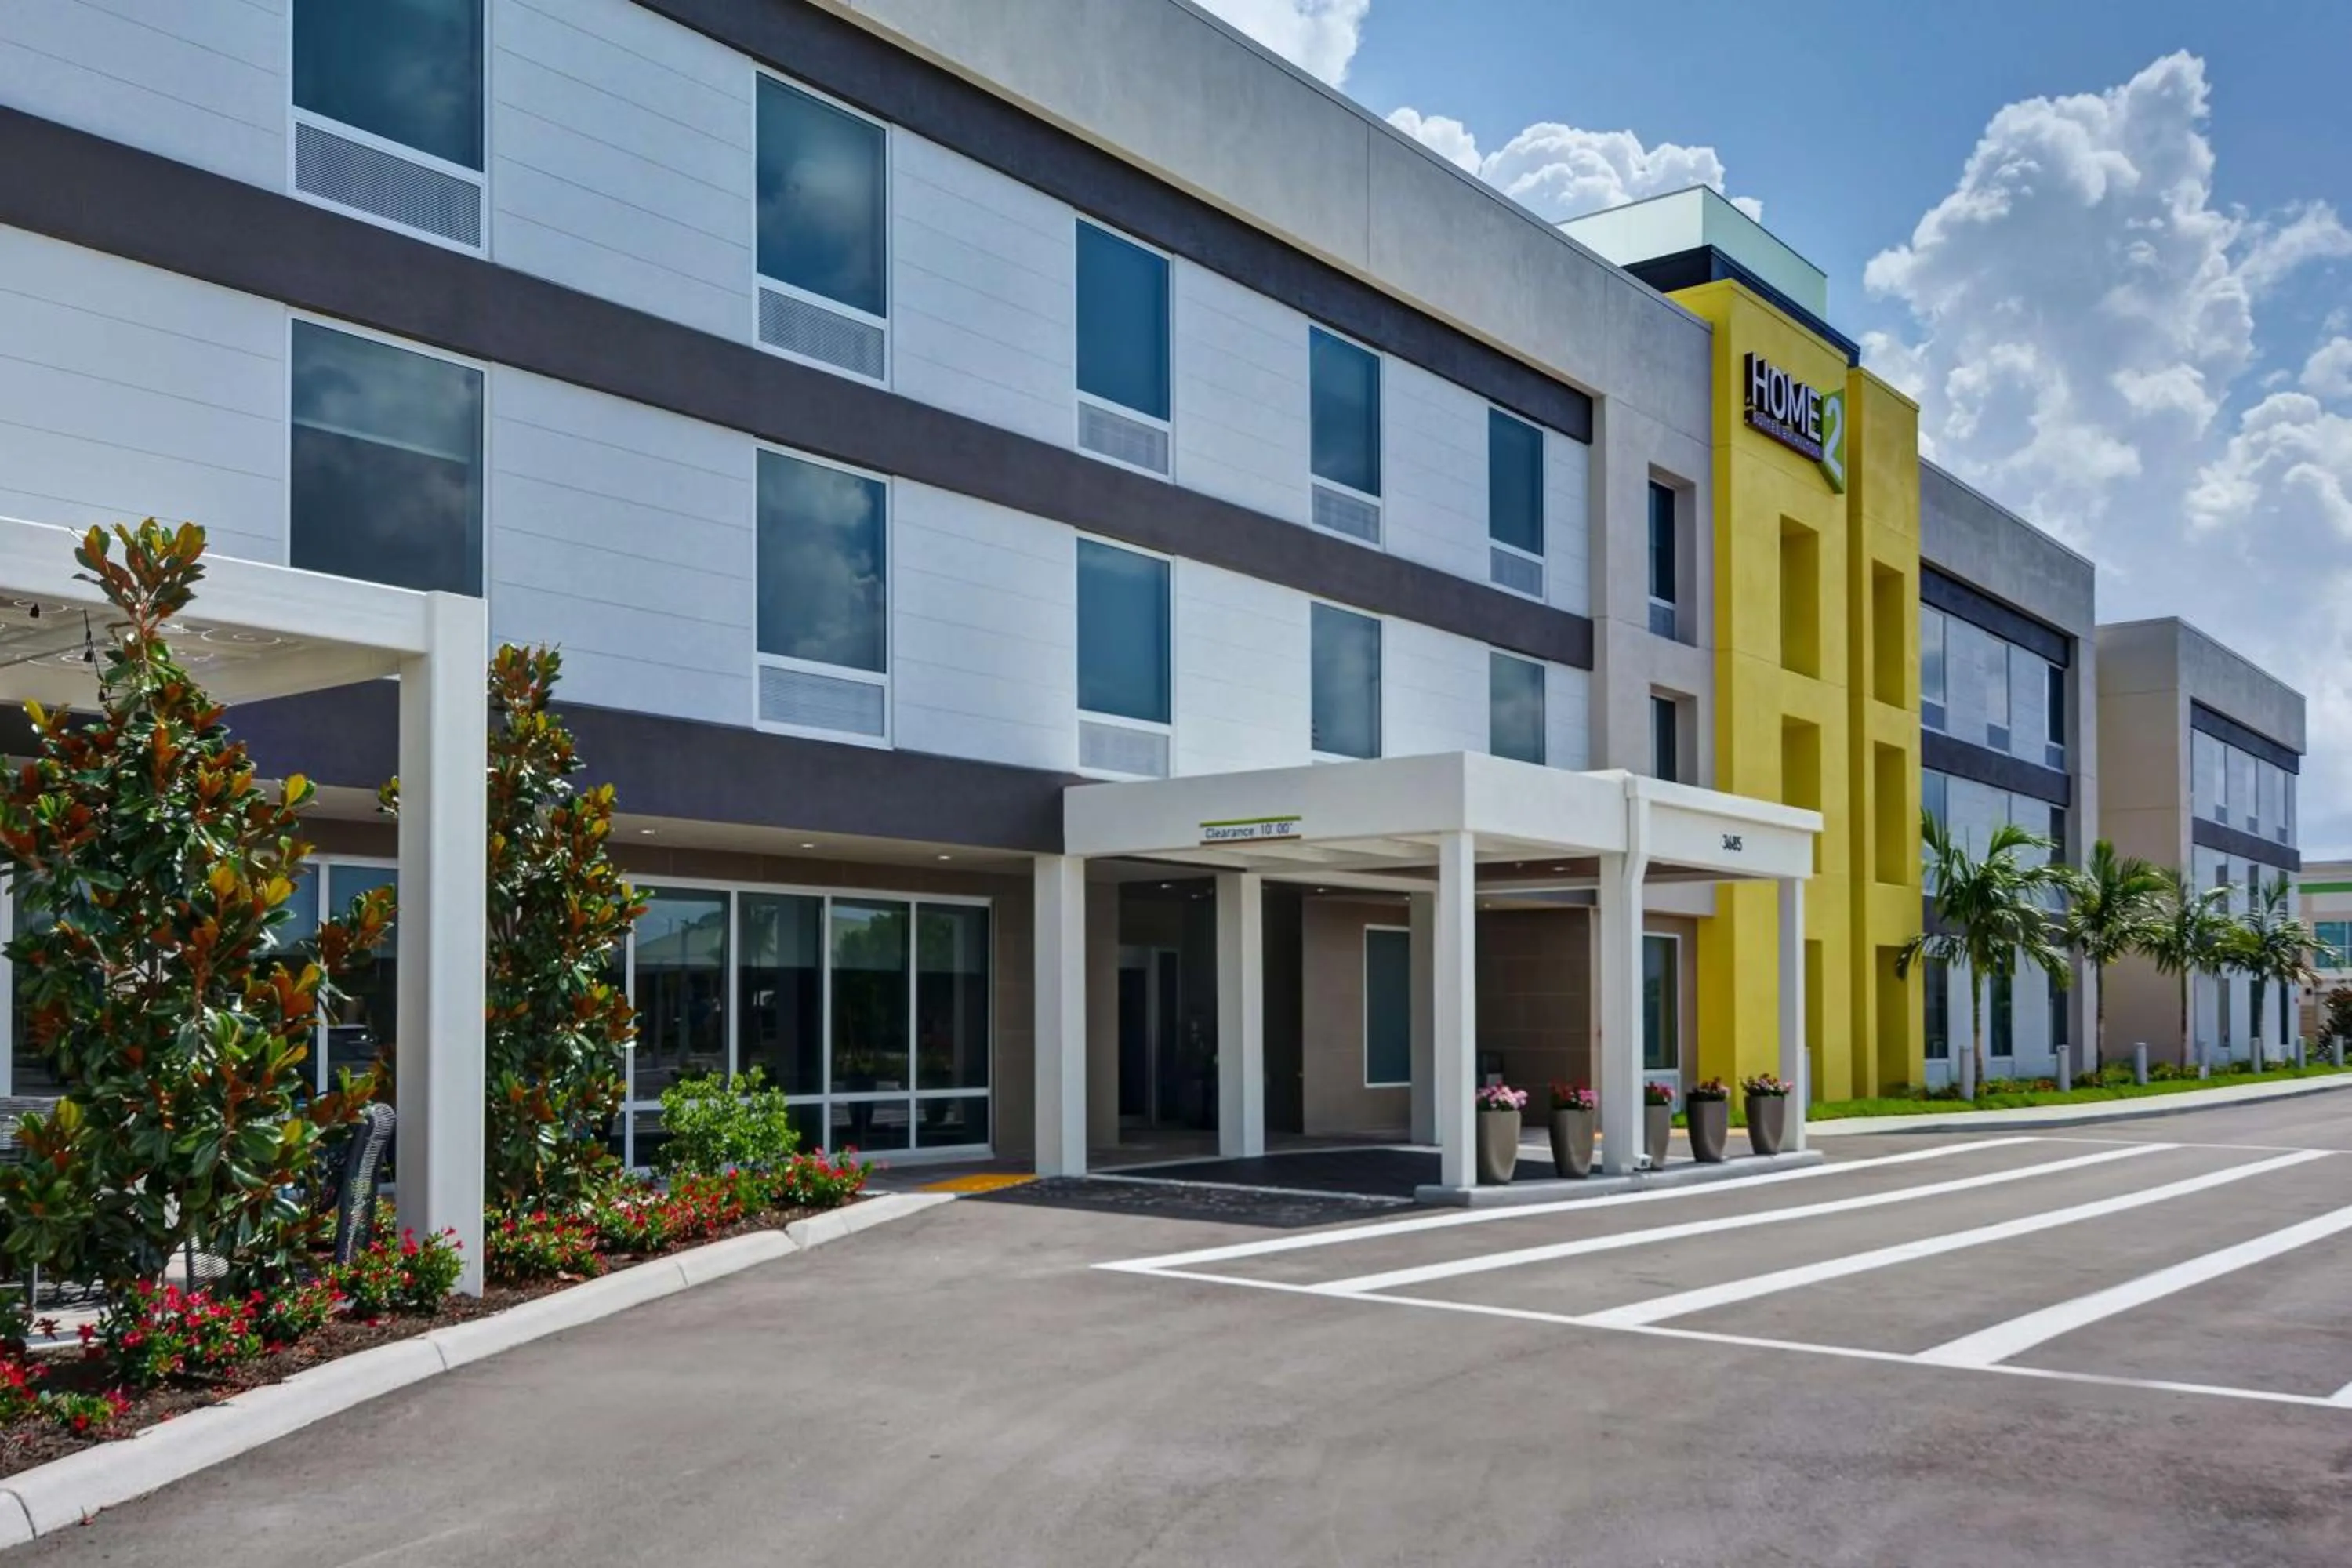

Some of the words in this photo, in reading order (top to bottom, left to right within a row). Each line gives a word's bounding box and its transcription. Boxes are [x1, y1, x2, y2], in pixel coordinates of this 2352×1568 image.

[1751, 351, 1822, 443] HOME
[1824, 395, 1844, 481] 2
[1204, 826, 1254, 839] Clearance
